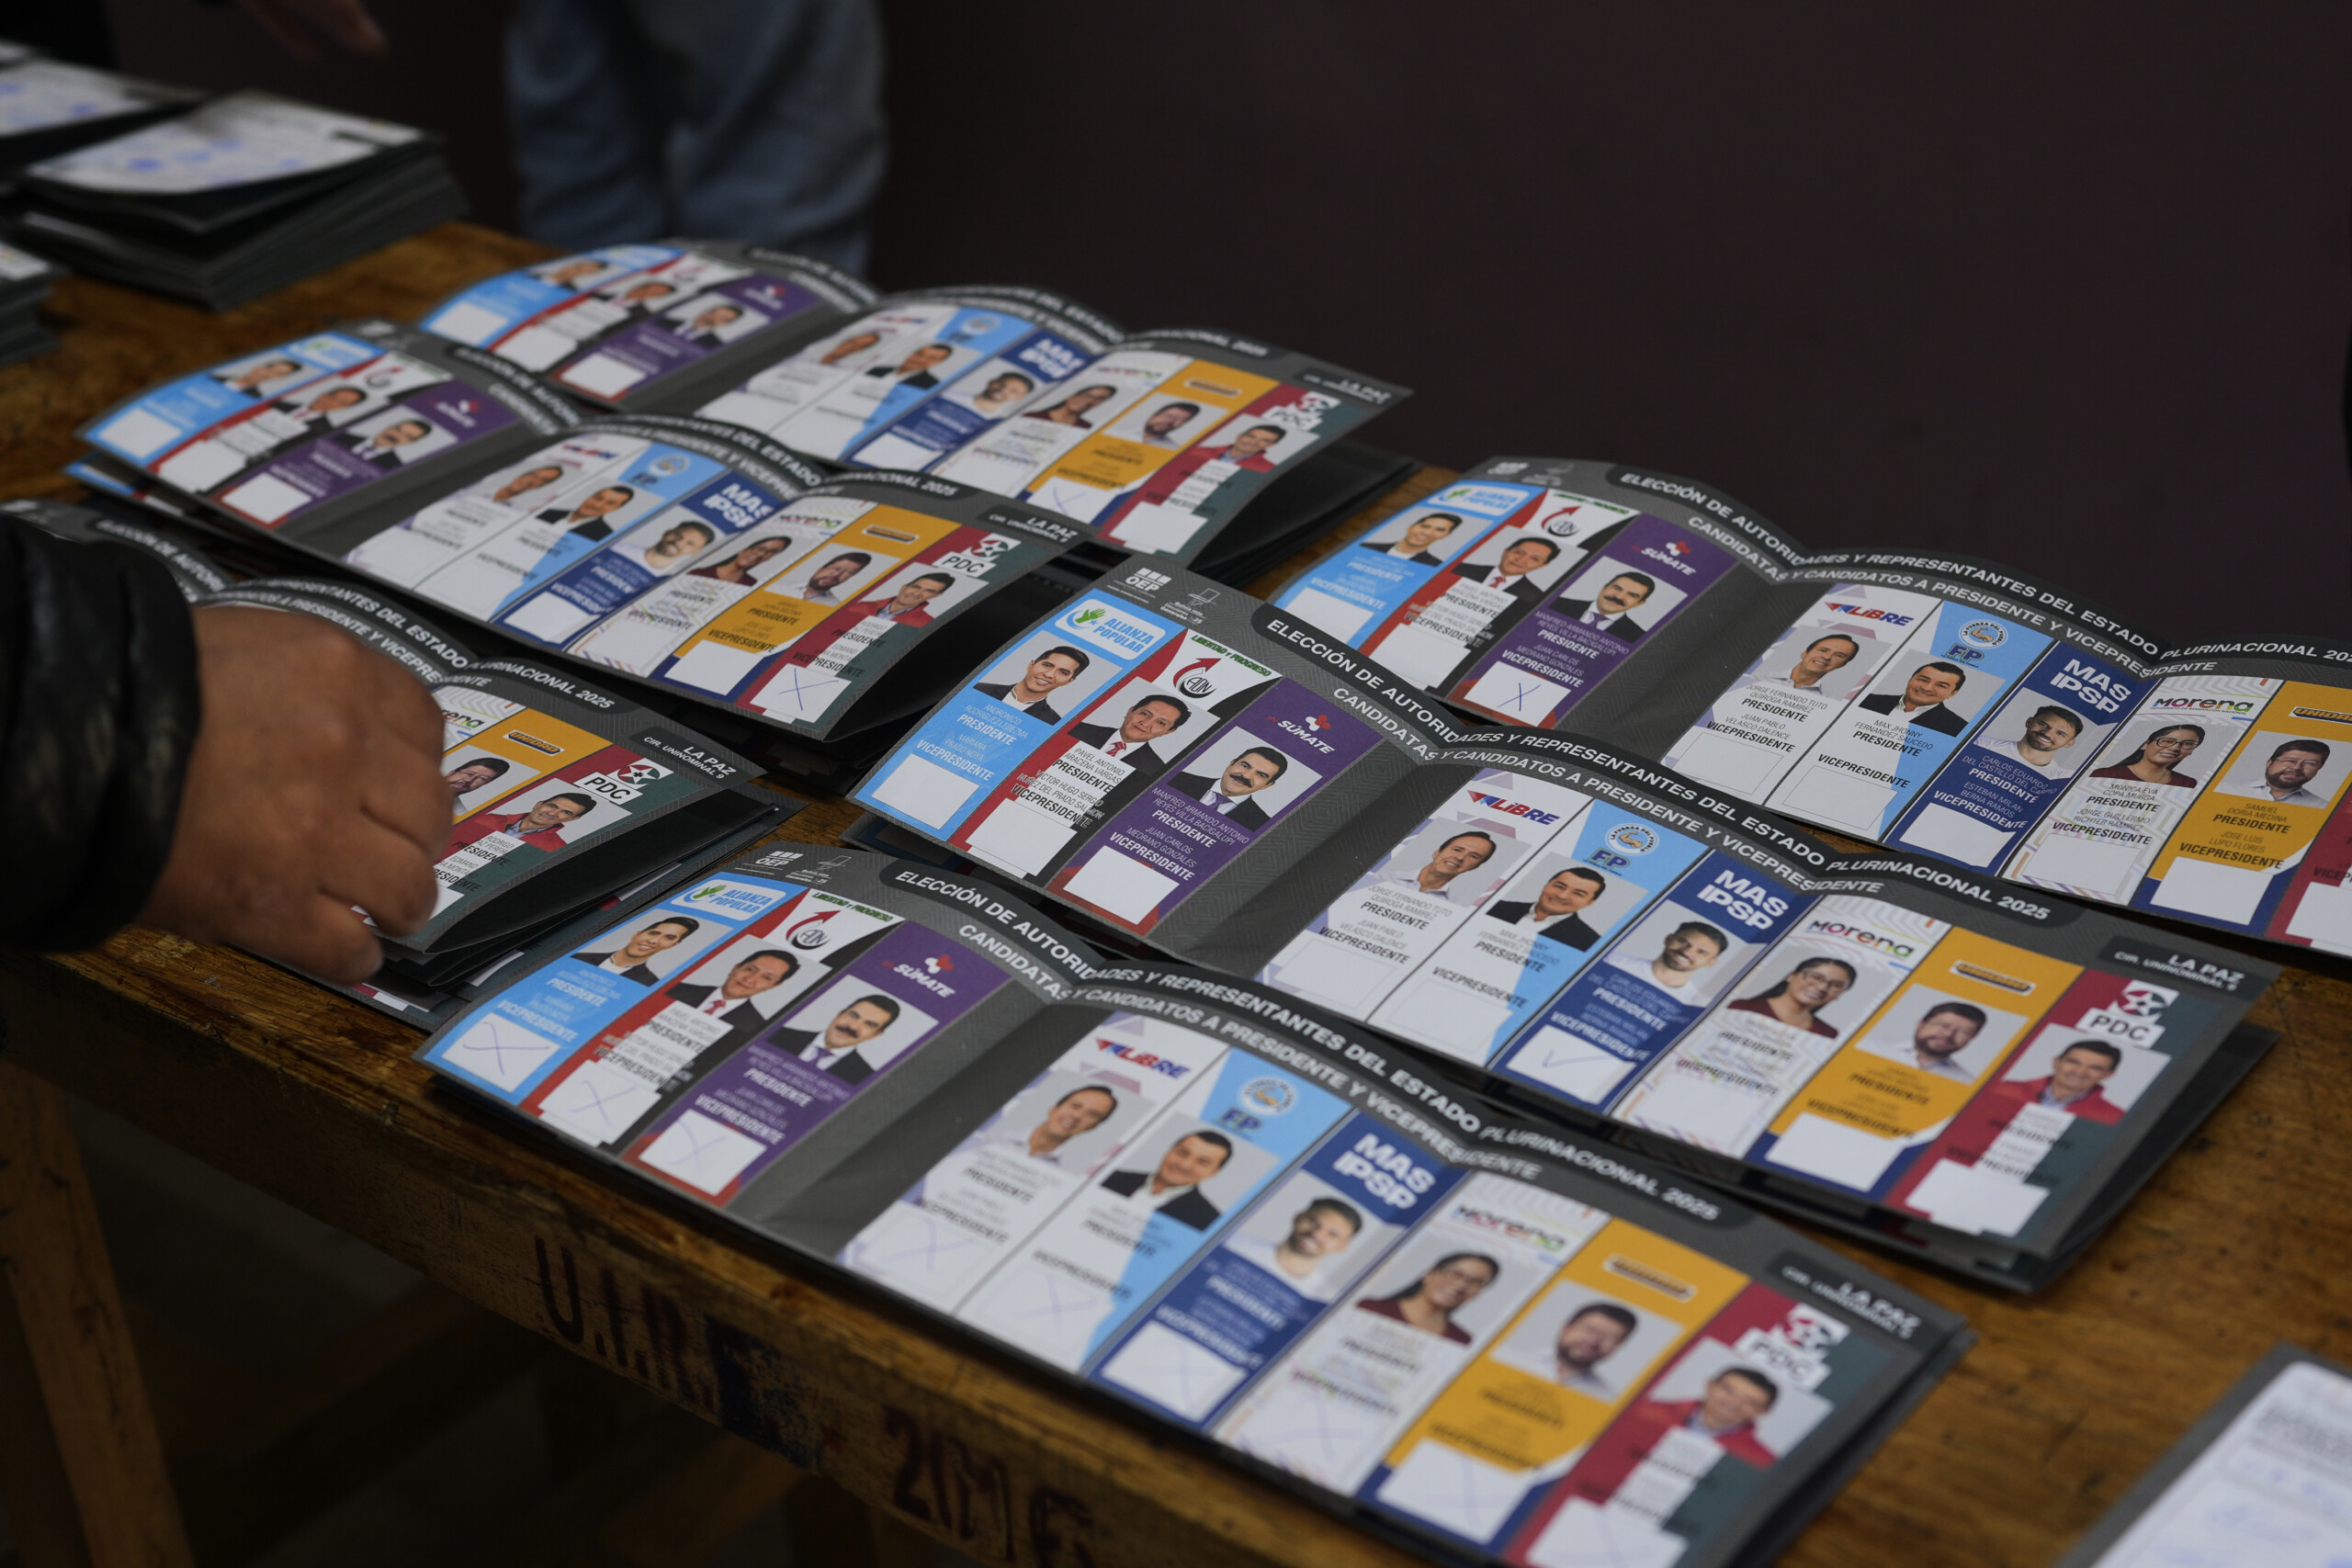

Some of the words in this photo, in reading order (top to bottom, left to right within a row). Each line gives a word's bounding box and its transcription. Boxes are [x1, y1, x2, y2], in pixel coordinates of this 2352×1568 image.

[944, 555, 985, 574] PDC
[1620, 472, 1707, 506] ELECCIÓN
[1706, 499, 1734, 519] DE
[1731, 515, 1849, 567] AUTORIDADES
[1853, 553, 1871, 564] Y
[1867, 553, 2038, 599] REPRESENTANTES
[2039, 592, 2076, 616] DEL
[2080, 609, 2159, 657] ESTADO
[2159, 642, 2318, 660] PLURINACIONAL
[1125, 575, 1160, 592] OEP
[1688, 516, 1788, 582] CANDIDATAS
[1790, 570, 1804, 581] Y
[1802, 568, 1913, 587] CANDIDATOS
[1914, 577, 1935, 590] A
[1931, 580, 2050, 626] PRESIDENTE
[2048, 619, 2064, 632] Y
[2064, 625, 2217, 680] VICEPRESIDENTE
[367, 630, 383, 643] Y
[1091, 626, 1146, 654] POPULAR
[1103, 617, 1155, 645] ALIANZA
[1536, 628, 1600, 660] PRESIDENTE
[375, 604, 410, 630] DEL
[404, 624, 469, 669] ESTADO
[575, 689, 616, 709] 2025
[1947, 643, 1984, 662] FP
[1501, 649, 1585, 689] VICEPRESIDENTE
[2063, 657, 2132, 703] MAS
[1746, 682, 1770, 697] JORGE
[1769, 688, 1809, 705] FERNANDO
[1807, 698, 1829, 711] TUTO
[1748, 691, 1784, 705] QUIROGA
[1781, 699, 1815, 715] RAMIREZ
[2049, 671, 2121, 715] IPSP
[983, 703, 1023, 726] ANDRONICO
[1741, 697, 1809, 724] PRESIDENTE
[1741, 712, 1762, 724] JUAN
[1760, 717, 1787, 730] PABLO
[507, 730, 561, 755] UNIDAD
[956, 713, 1018, 748] PRESIDENTE
[956, 732, 989, 753] MARIANA
[1276, 716, 1336, 756] SÚMATE
[1706, 719, 1796, 755] VICEPRESIDENTE
[1724, 716, 1758, 732] VELASCO
[1757, 724, 1792, 741] DALENCE
[1853, 720, 1901, 740] FERNANDEZ
[1897, 734, 1935, 751] SAUCEDO
[1873, 718, 1891, 730] MAX
[1891, 723, 1924, 739] JHONNY
[643, 736, 662, 750] CIR.
[662, 743, 719, 775] UNINOMINAL
[716, 771, 726, 780] 9
[965, 747, 986, 762] NOYA
[1851, 730, 1923, 758] PRESIDENTE
[682, 745, 699, 758] LA
[702, 755, 738, 777] PAZ
[915, 739, 995, 784] VICEPRESIDENTE
[1063, 752, 1095, 772] ARACENA
[1094, 767, 1123, 785] VARGAS
[1074, 748, 1096, 763] PAVEL
[1095, 757, 1126, 777] ANTONIO
[1266, 618, 1361, 673] ELECCIÓN
[1354, 668, 1385, 690] DE
[1381, 682, 1504, 745] AUTORIDADES
[1506, 734, 1522, 744] Y
[1520, 735, 1698, 801] REPRESENTANTES
[1697, 790, 1737, 821] DEL
[1740, 818, 1826, 866] ESTADO
[1825, 860, 1993, 905] PLURINACIONAL
[1997, 894, 2051, 920] 2025
[1816, 752, 1912, 790] VICEPRESIDENTE
[1962, 754, 1976, 767] DEL
[1978, 761, 2016, 782] CASTILLO
[2014, 776, 2029, 790] DEL
[1982, 754, 2014, 772] CARLOS
[583, 776, 631, 801] PDC
[1051, 759, 1115, 794] PRESIDENTE
[1058, 780, 1080, 796] HUGO
[1332, 687, 1439, 761] CANDIDATAS
[1440, 750, 1454, 761] Y
[1453, 750, 1566, 777] CANDIDATOS
[1566, 772, 1586, 784] A
[1583, 777, 1704, 833] PRESIDENTE
[1706, 826, 1723, 839] Y
[1722, 832, 1885, 893] VICEPRESIDENTE
[1968, 767, 2040, 804] PRESIDENTE
[1011, 783, 1095, 829] VICEPRESIDENTE
[1038, 782, 1053, 794] DEL
[1052, 789, 1076, 804] PRADO
[1960, 789, 1987, 806] BERNA
[1986, 800, 2016, 818] RAMOS
[1963, 781, 1998, 801] ESTEBAN
[1996, 795, 2025, 813] MILAN
[2086, 795, 2161, 813] PRESIDENTE
[2244, 802, 2279, 814] SAMUEL
[1150, 787, 1186, 813] MANFRED
[1183, 803, 1221, 828] ARMANDO
[1217, 821, 1250, 845] ANTONIO
[1153, 797, 1177, 815] REYES
[1175, 807, 1195, 825] VILLA
[1193, 817, 1236, 847] BACIGALUPI
[1932, 790, 2029, 829] VICEPRESIDENTE
[2212, 813, 2292, 835] PRESIDENTE
[2226, 807, 2254, 818] DORIA
[2254, 810, 2288, 823] MEDINA
[1145, 826, 1165, 840] JUAN
[1163, 834, 1194, 855] CARLOS
[1151, 809, 1217, 849] PRESIDENTE
[2052, 821, 2154, 845] VICEPRESIDENTE
[2243, 834, 2265, 844] LUIS
[451, 840, 512, 866] PRESIDENTE
[754, 856, 790, 867] OEP
[1109, 830, 1195, 882] VICEPRESIDENTE
[1126, 827, 1161, 850] MEDRANO
[1159, 842, 1197, 868] GONZALES
[1590, 849, 1628, 869] FP
[2178, 842, 2285, 870] VICEPRESIDENTE
[708, 896, 763, 915] POPULAR
[723, 888, 773, 907] ALIANZA
[1697, 884, 1774, 931] IPSP
[1713, 869, 1790, 917] MAS
[1360, 901, 1430, 931] PRESIDENTE
[1318, 925, 1411, 966] VICEPRESIDENTE
[1473, 940, 1547, 974] PRESIDENTE
[2166, 953, 2202, 972] LA
[894, 870, 990, 909] ELECCIÓN
[984, 901, 1018, 926] DE
[1012, 919, 1146, 983] AUTORIDADES
[1145, 971, 1162, 983] Y
[1157, 968, 1346, 1052] REPRESENTANTES
[1344, 1039, 1388, 1079] DEL
[1385, 1068, 1481, 1134] ESTADO
[1431, 965, 1530, 1010] VICEPRESIDENTE
[957, 923, 1071, 1002] CANDIDATAS
[1200, 1012, 1221, 1030] A
[1218, 1020, 1351, 1096] PRESIDENTE
[1348, 1083, 1369, 1101] Y
[2088, 1013, 2151, 1043] PDC
[1353, 1133, 1435, 1194] MAS
[1333, 1151, 1417, 1210] IPSP
